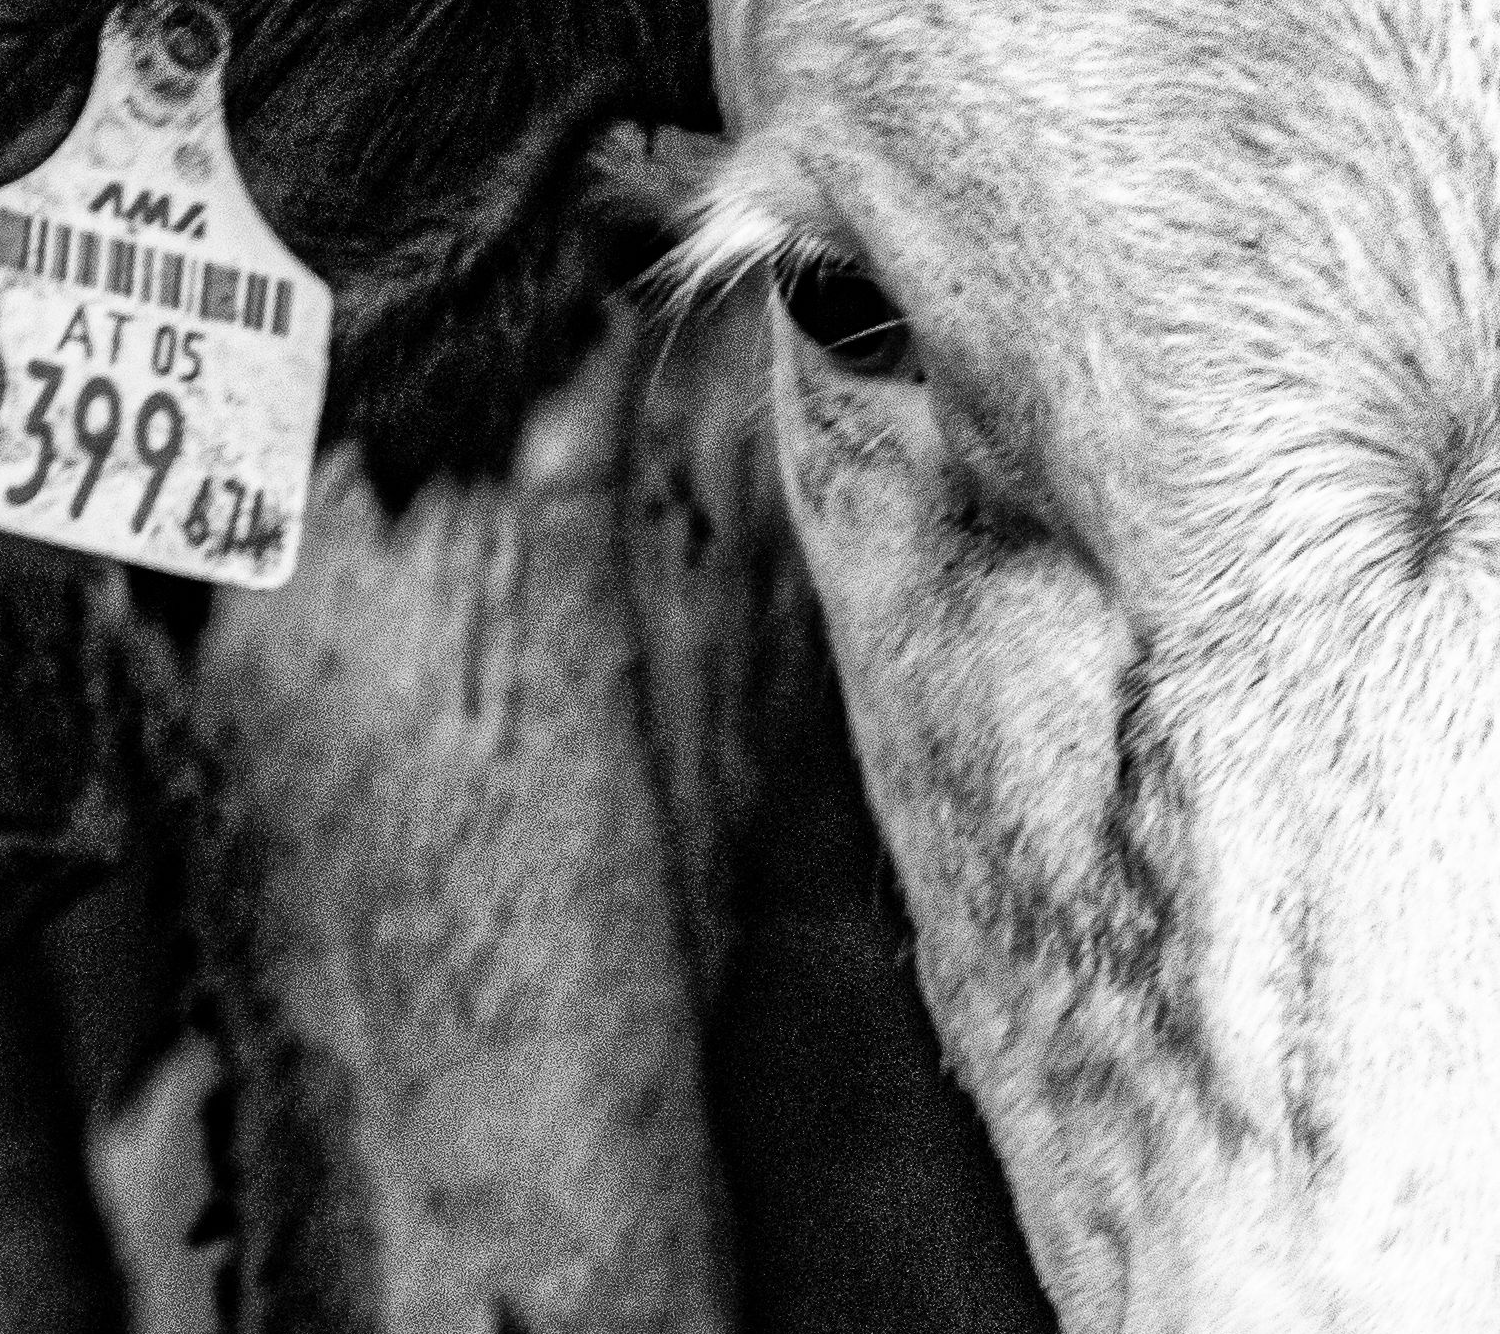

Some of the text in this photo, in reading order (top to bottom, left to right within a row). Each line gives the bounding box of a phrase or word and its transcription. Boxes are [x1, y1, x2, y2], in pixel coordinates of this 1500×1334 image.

[89, 182, 209, 240] AMA
[58, 304, 203, 382] AT 05
